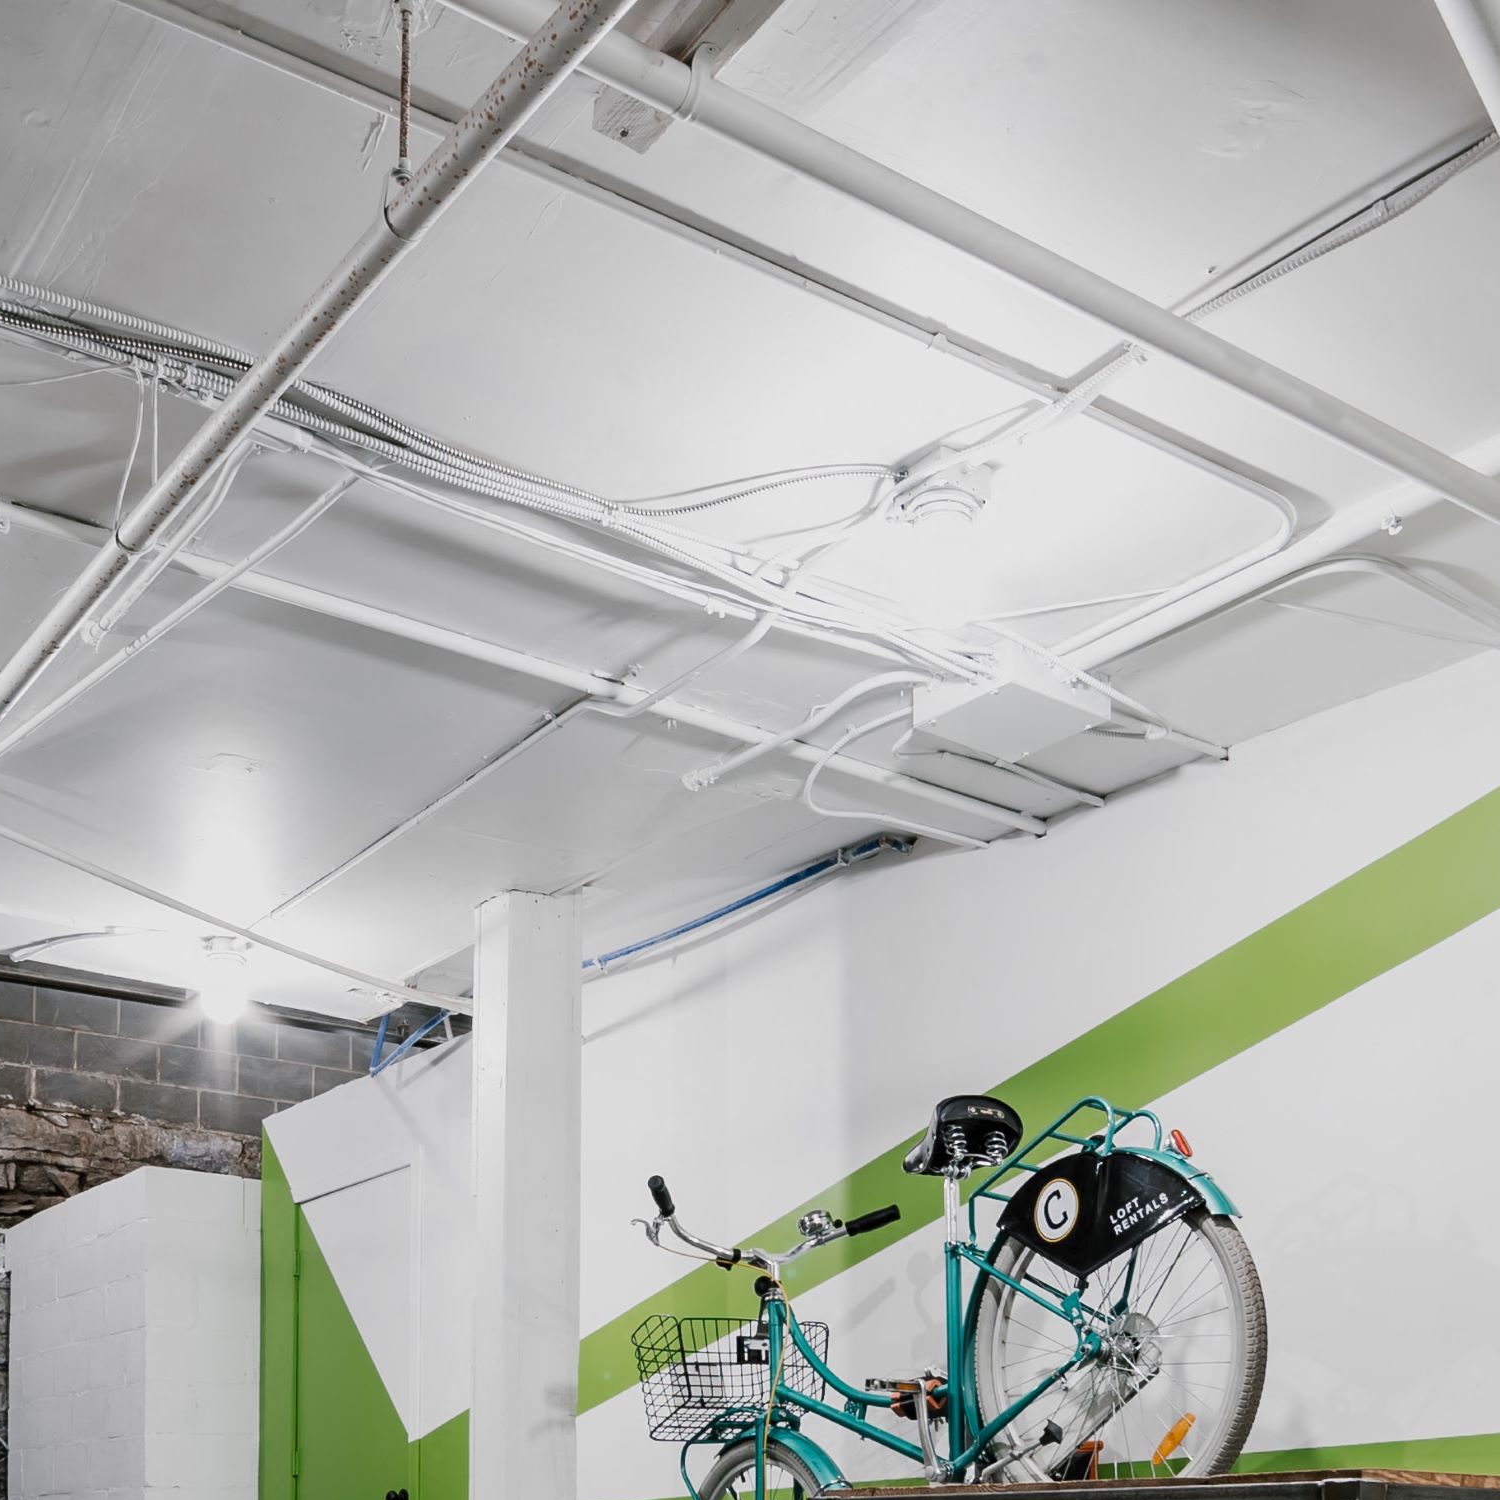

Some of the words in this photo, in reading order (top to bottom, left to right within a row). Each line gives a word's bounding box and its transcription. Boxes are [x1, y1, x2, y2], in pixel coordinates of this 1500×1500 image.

[1043, 1189, 1069, 1231] C
[1109, 1197, 1140, 1225] LOFT
[1113, 1192, 1169, 1236] RENTALS
